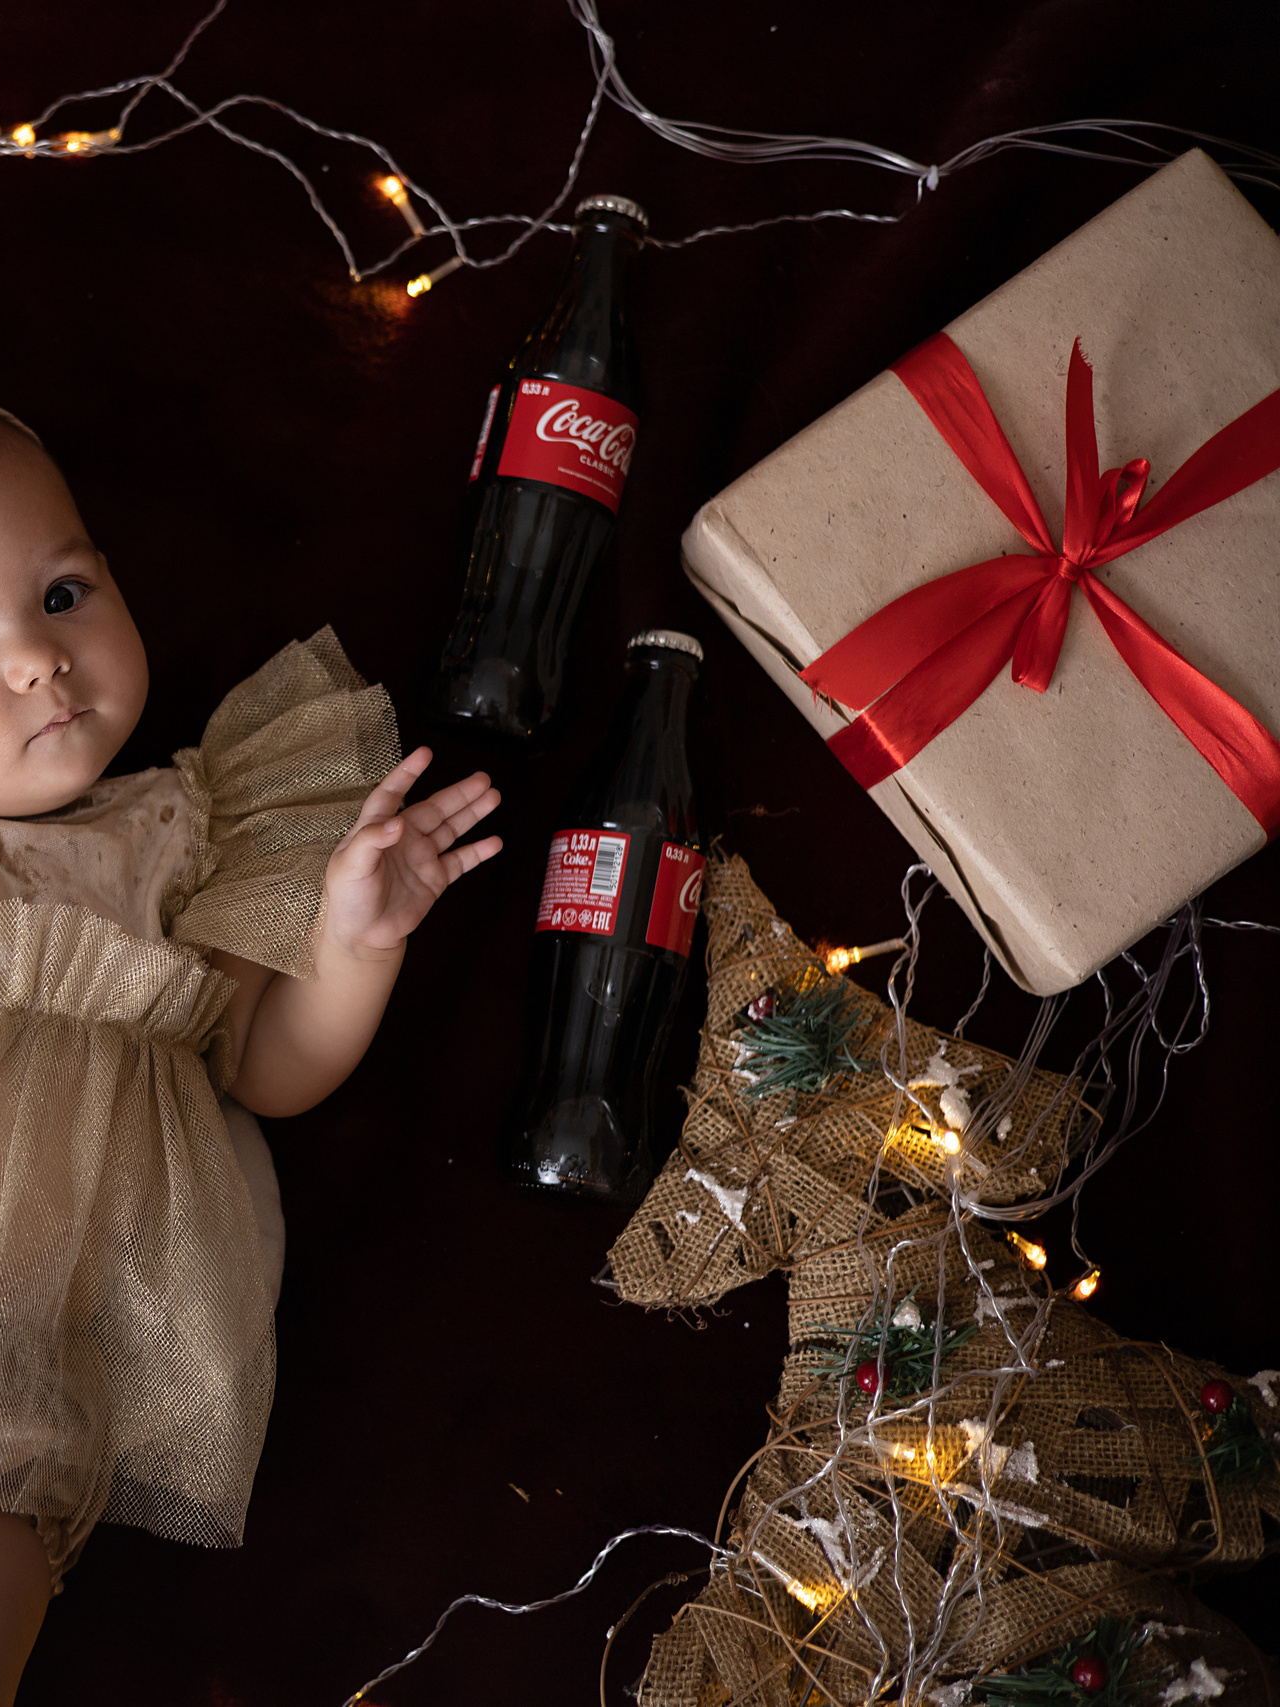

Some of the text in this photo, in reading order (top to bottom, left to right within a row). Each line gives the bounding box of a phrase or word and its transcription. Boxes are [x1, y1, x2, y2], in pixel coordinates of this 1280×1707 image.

[522, 382, 541, 395] 0,33
[580, 454, 615, 478] CLASSIC
[570, 833, 589, 852] 0,33
[665, 846, 683, 862] 0,33
